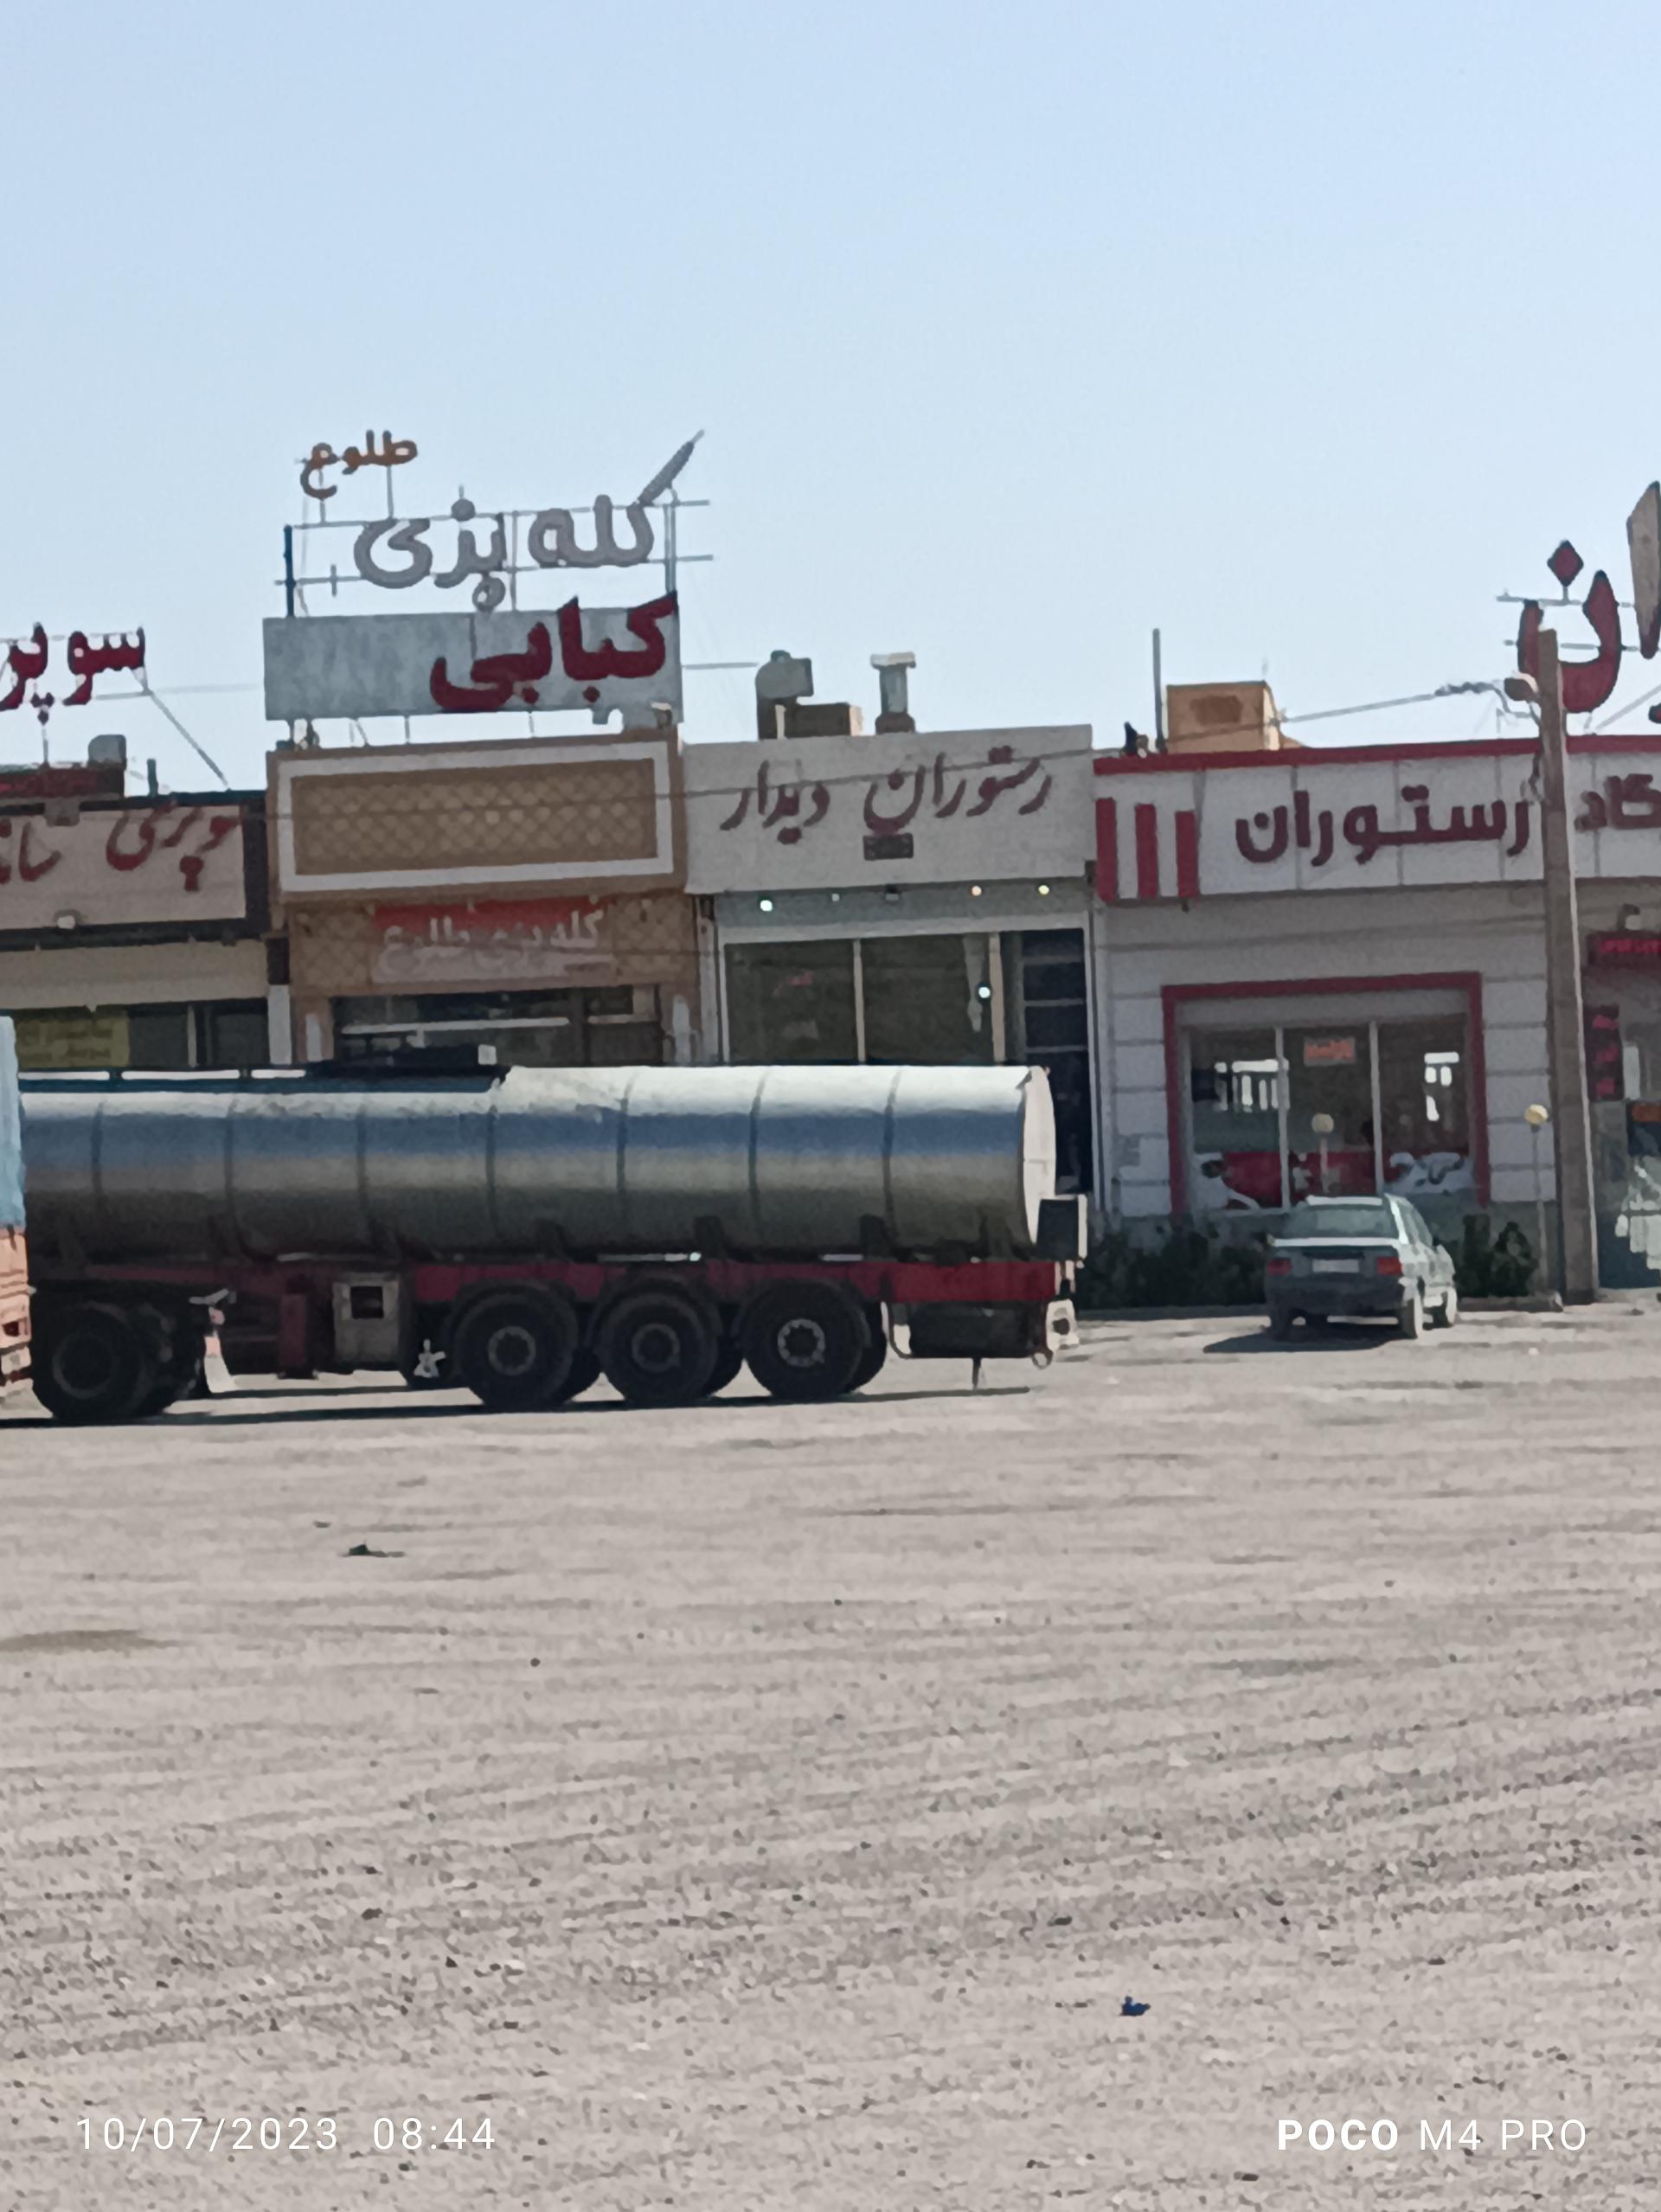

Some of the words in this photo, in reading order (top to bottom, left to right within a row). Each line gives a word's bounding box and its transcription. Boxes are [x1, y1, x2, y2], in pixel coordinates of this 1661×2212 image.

[300, 429, 418, 500] طلوع
[528, 430, 704, 568] کله
[354, 497, 507, 613] پزی
[429, 589, 679, 711] کبابی
[1235, 785, 1530, 866] رستوران
